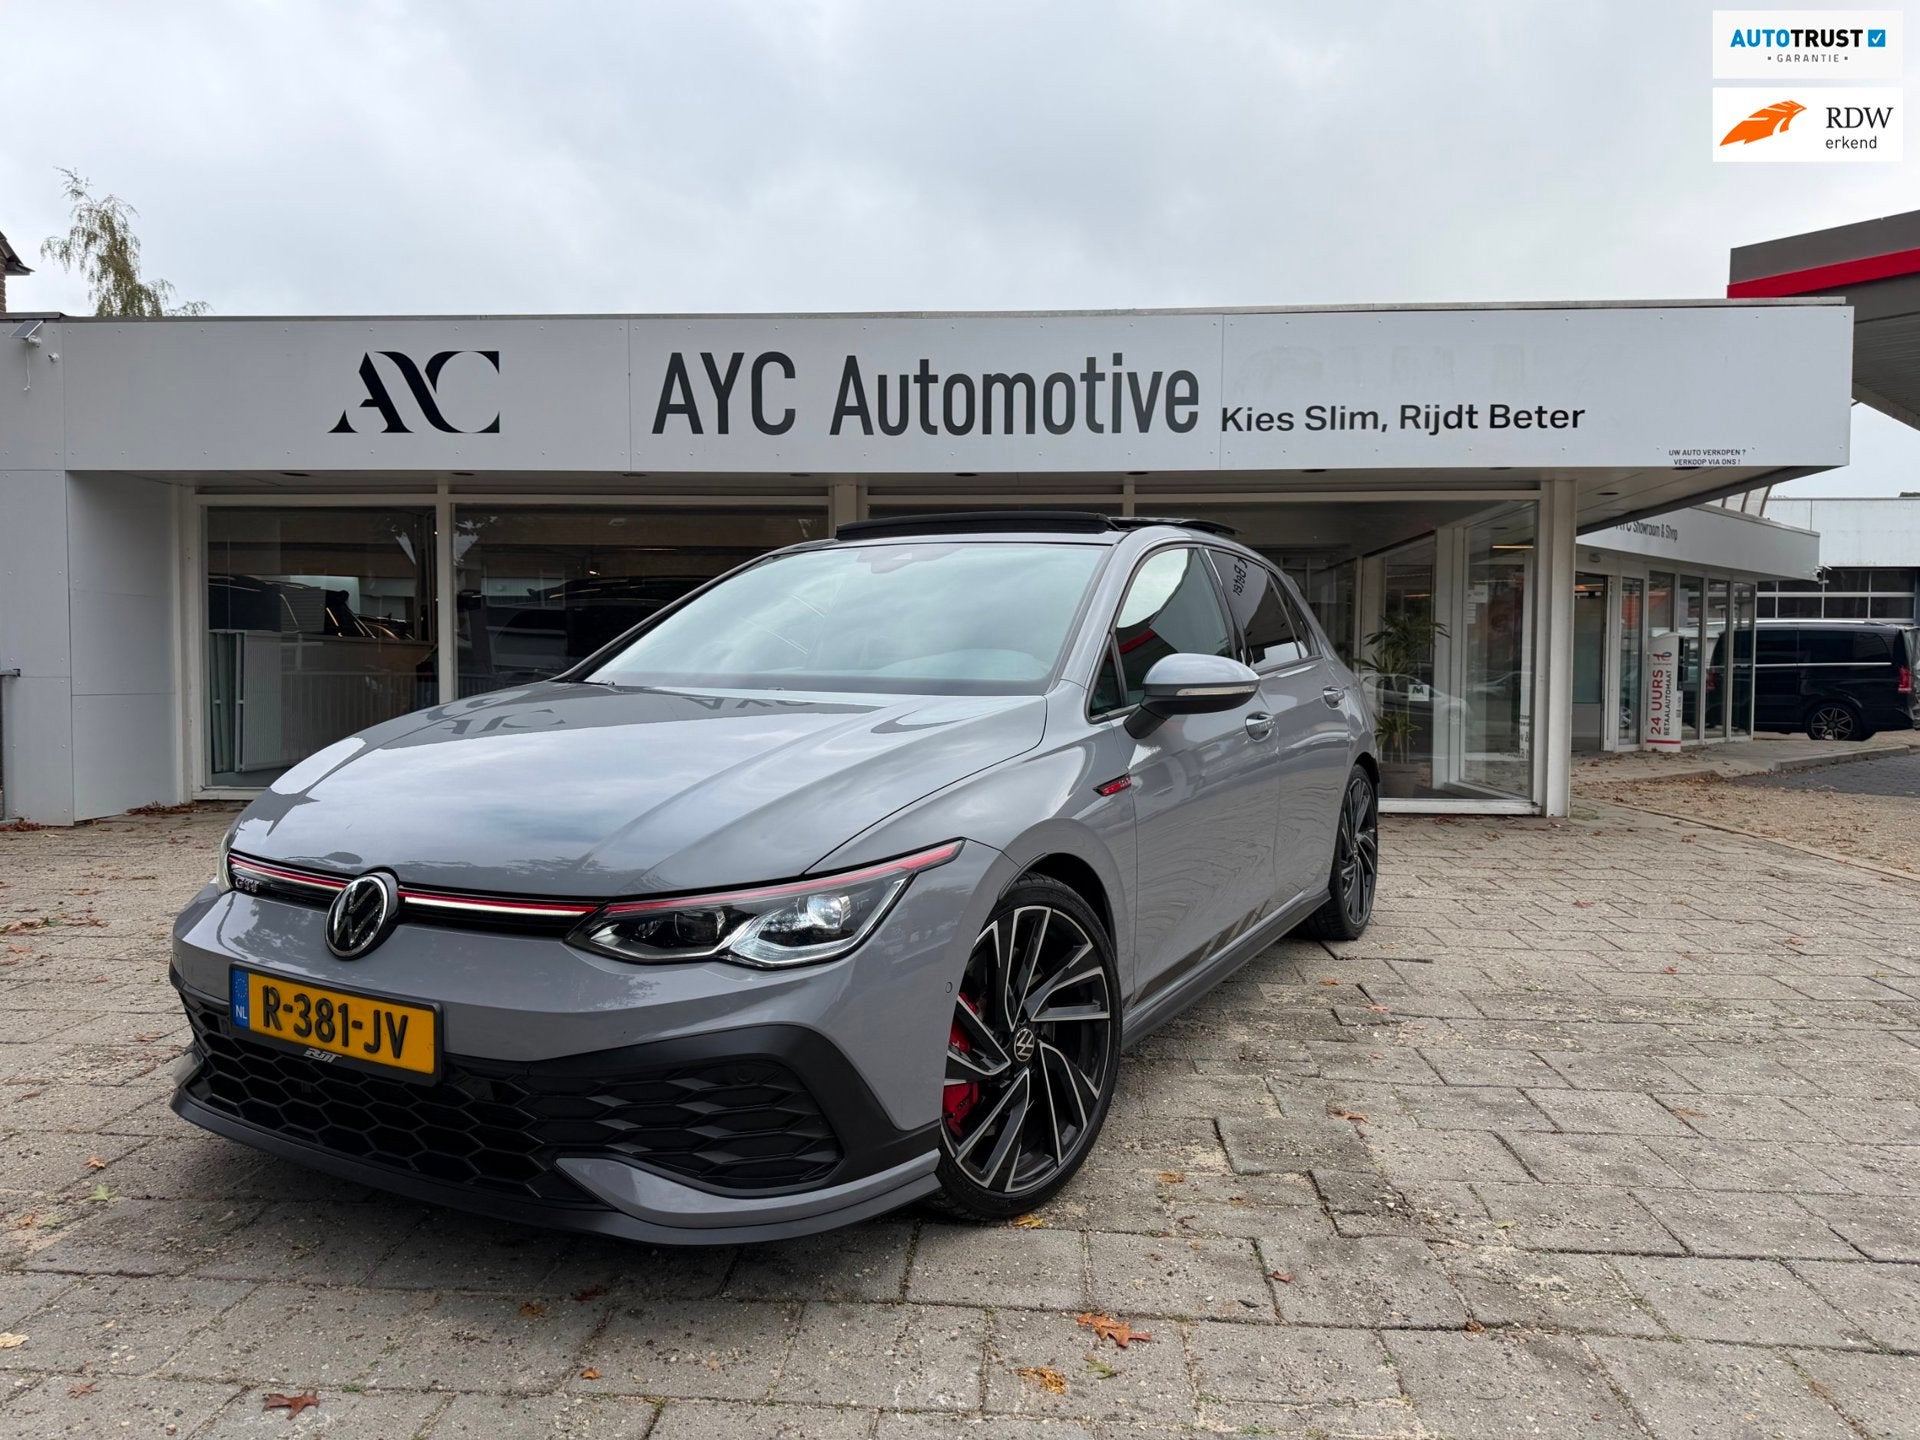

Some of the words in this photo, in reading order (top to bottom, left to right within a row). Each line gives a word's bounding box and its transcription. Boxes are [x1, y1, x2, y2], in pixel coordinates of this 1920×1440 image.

[652, 351, 796, 436] AYC
[829, 352, 1199, 436] Automotive
[1221, 406, 1294, 432] Kies
[1304, 404, 1388, 433] Slim,
[1400, 404, 1478, 436] Rijdt
[1489, 403, 1585, 429] Beter
[1651, 669, 1663, 711] UURS
[1663, 670, 1672, 736] BETAALAUTOMAAT
[1650, 717, 1662, 735] 24
[235, 1004, 248, 1020] NL
[262, 984, 408, 1060] R-381-JV
